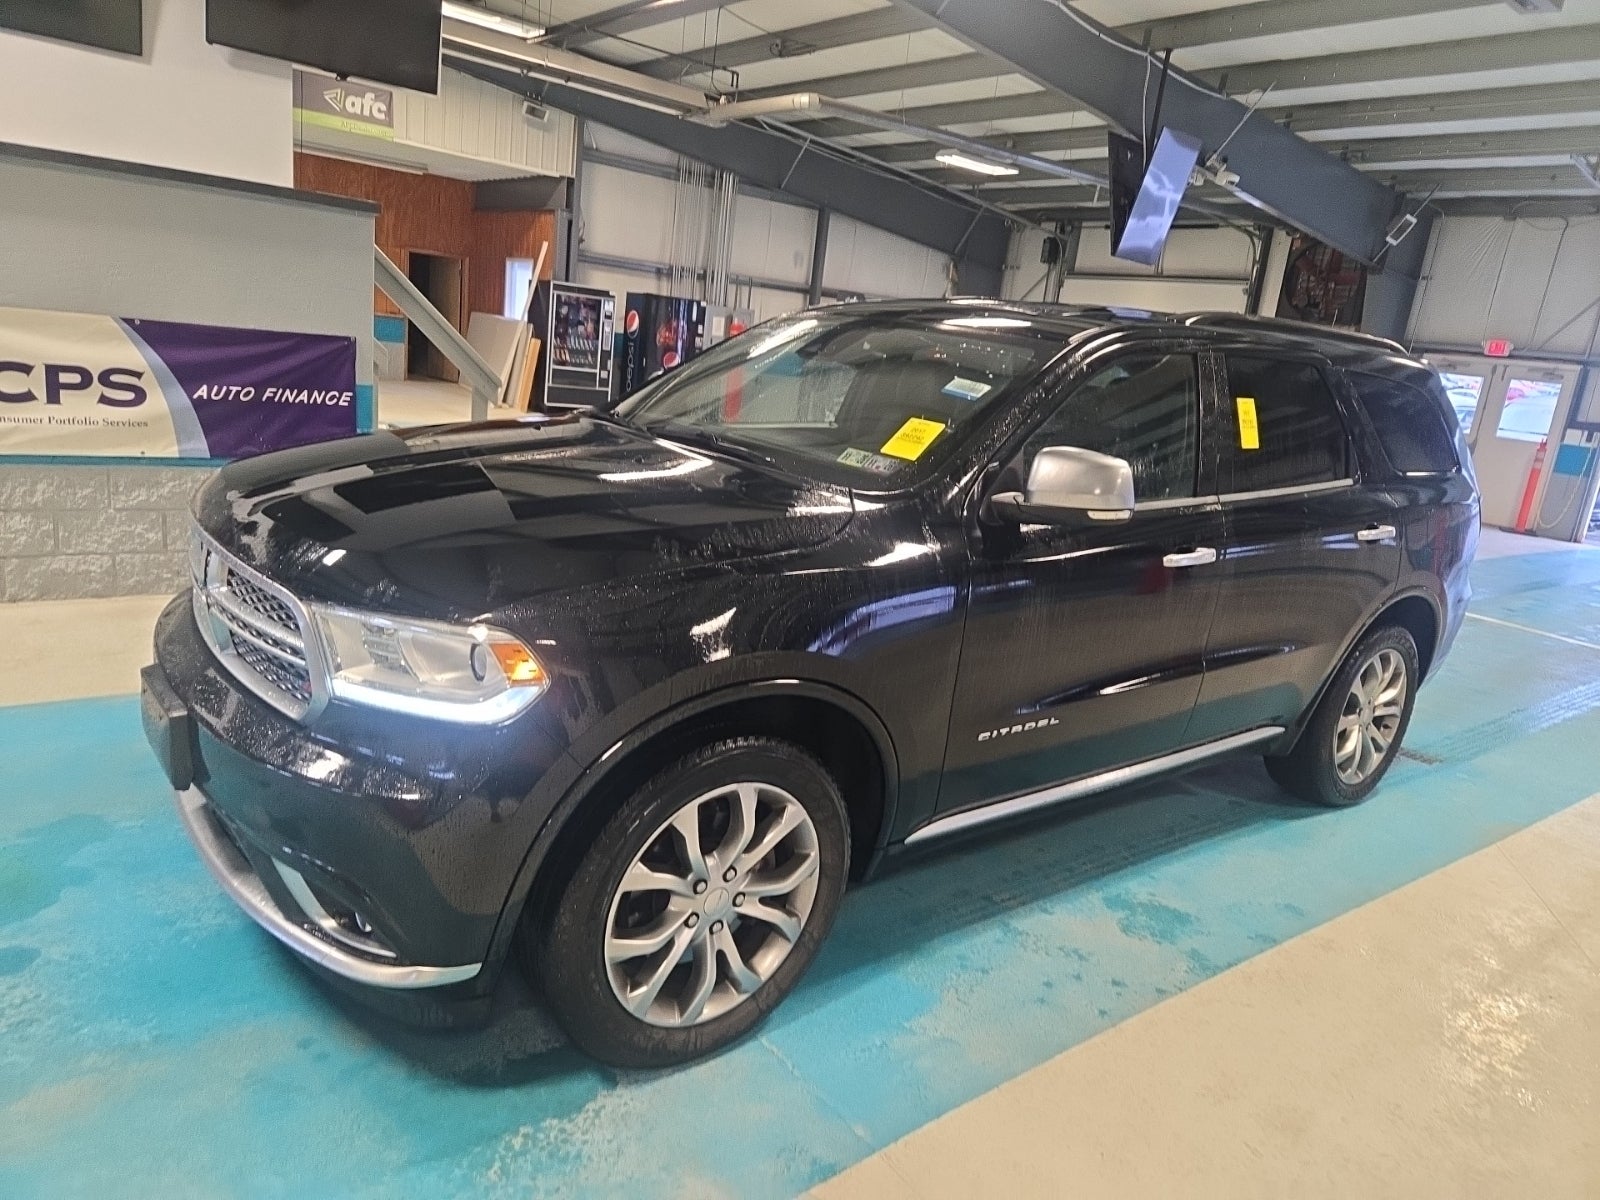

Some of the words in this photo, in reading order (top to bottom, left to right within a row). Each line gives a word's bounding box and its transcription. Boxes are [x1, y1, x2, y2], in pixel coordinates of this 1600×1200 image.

[345, 92, 387, 120] afc
[0, 361, 147, 408] CPS
[192, 384, 255, 402] AUTO
[261, 387, 354, 407] FINANCE
[47, 415, 100, 427] Portfolio
[101, 417, 149, 428] Services
[978, 717, 1060, 741] CITADEL
